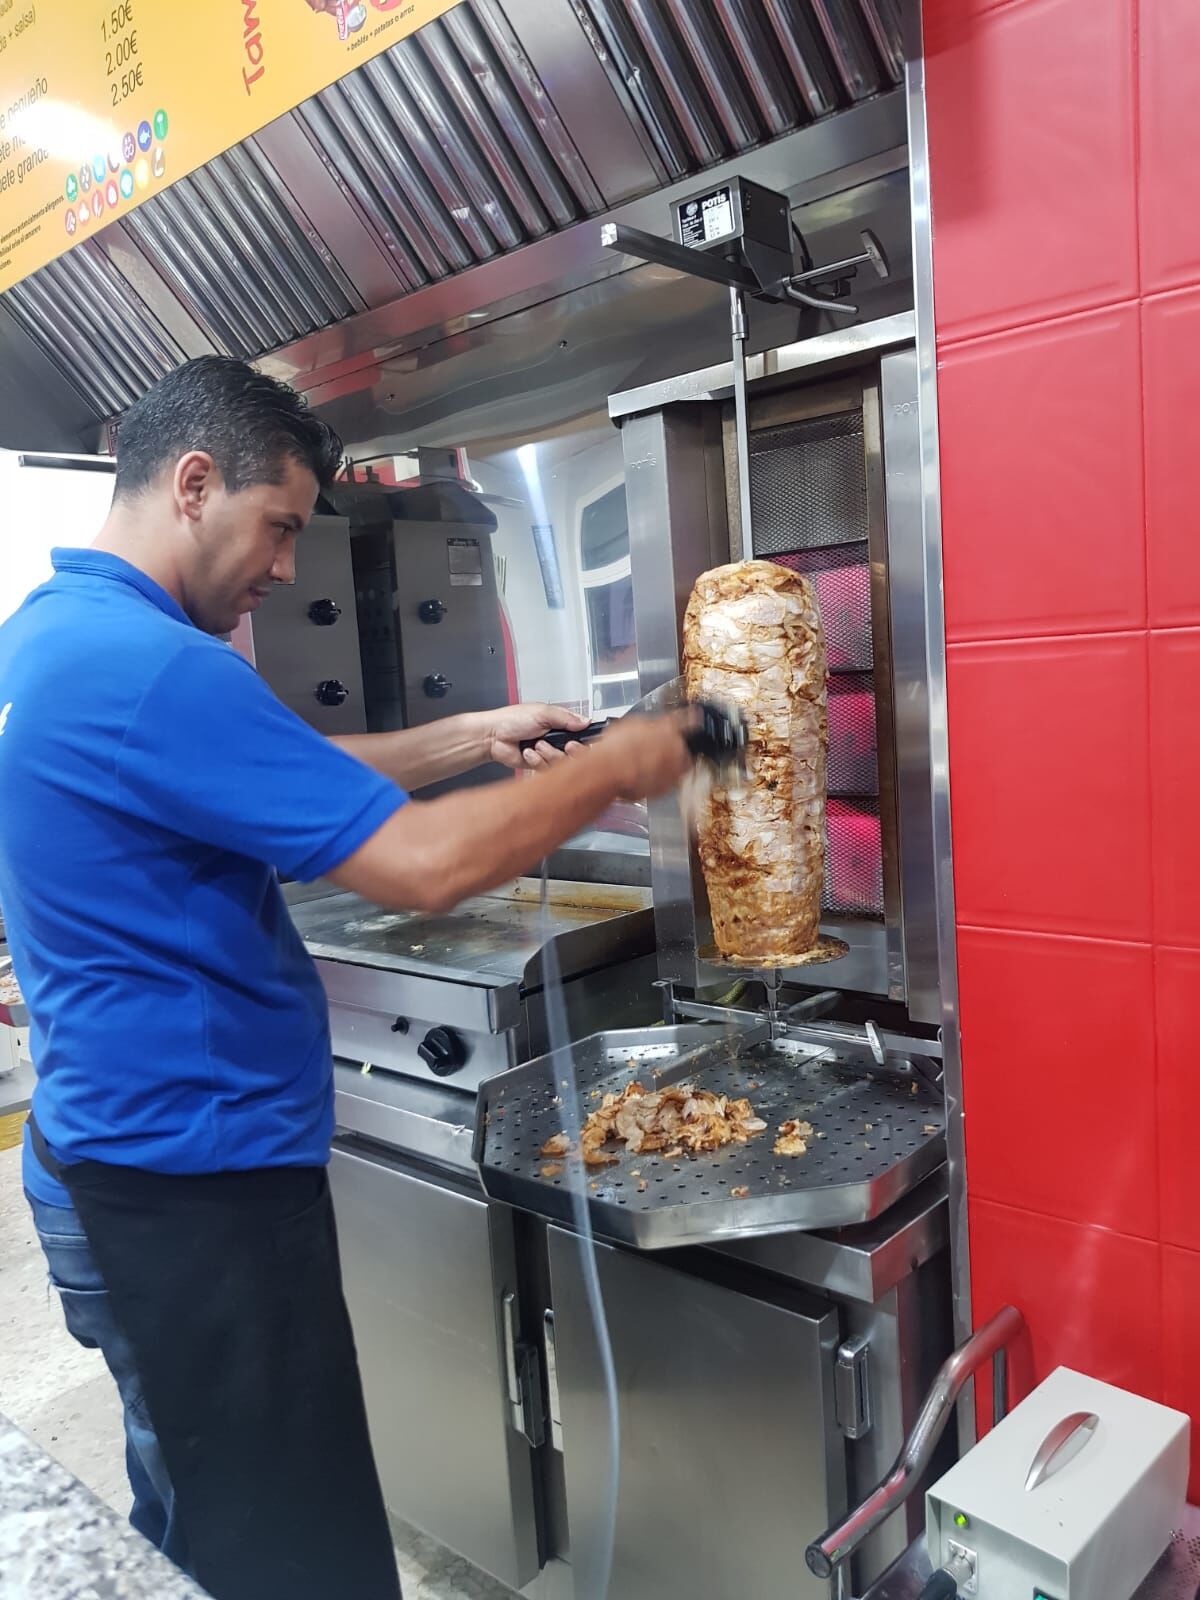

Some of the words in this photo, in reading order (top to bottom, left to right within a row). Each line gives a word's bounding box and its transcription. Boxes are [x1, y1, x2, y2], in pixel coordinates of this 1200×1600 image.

[101, 0, 133, 42] 1.50€
[105, 30, 138, 76] 2.00€
[111, 62, 144, 107] 2.50€
[701, 191, 727, 211] POTIS
